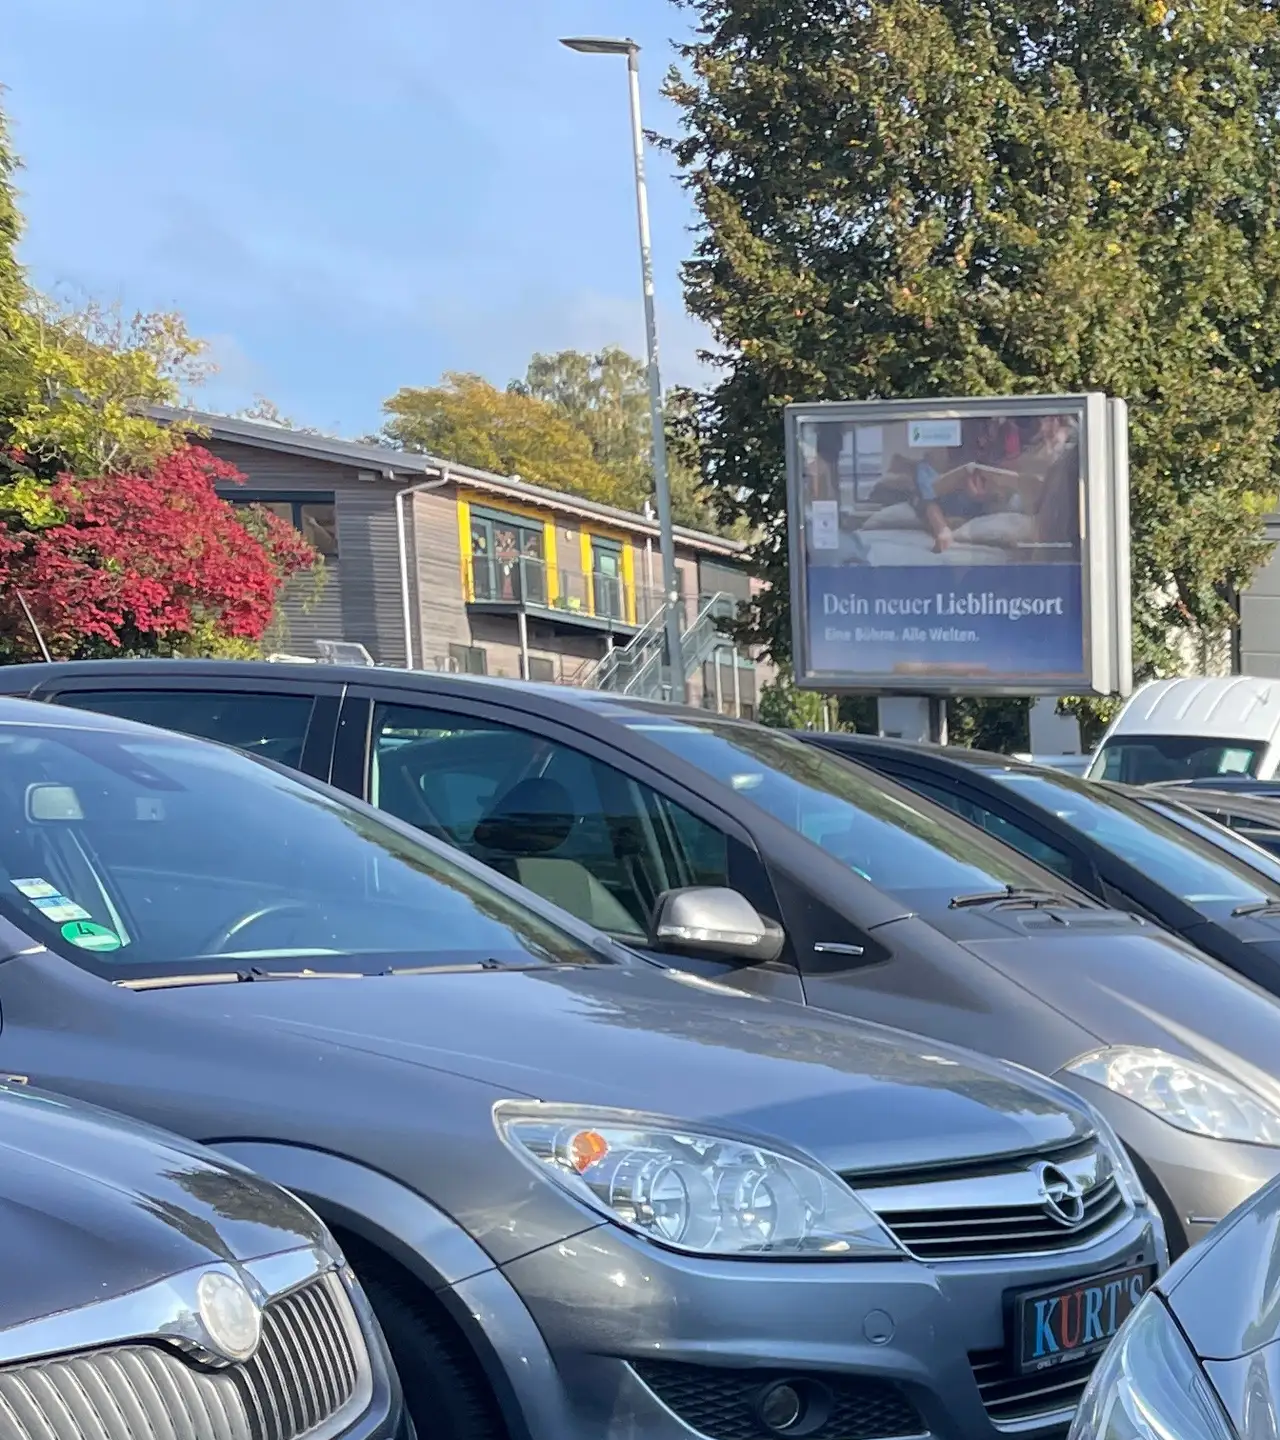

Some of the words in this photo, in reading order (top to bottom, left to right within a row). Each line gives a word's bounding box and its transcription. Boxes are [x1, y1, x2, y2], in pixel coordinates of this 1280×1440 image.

[823, 593, 868, 616] Dein
[875, 599, 932, 616] neuer
[936, 593, 1063, 620] Lieblingsort
[825, 627, 851, 641] Eine
[902, 627, 926, 641] Alle
[1032, 1274, 1144, 1357] KURT'S
